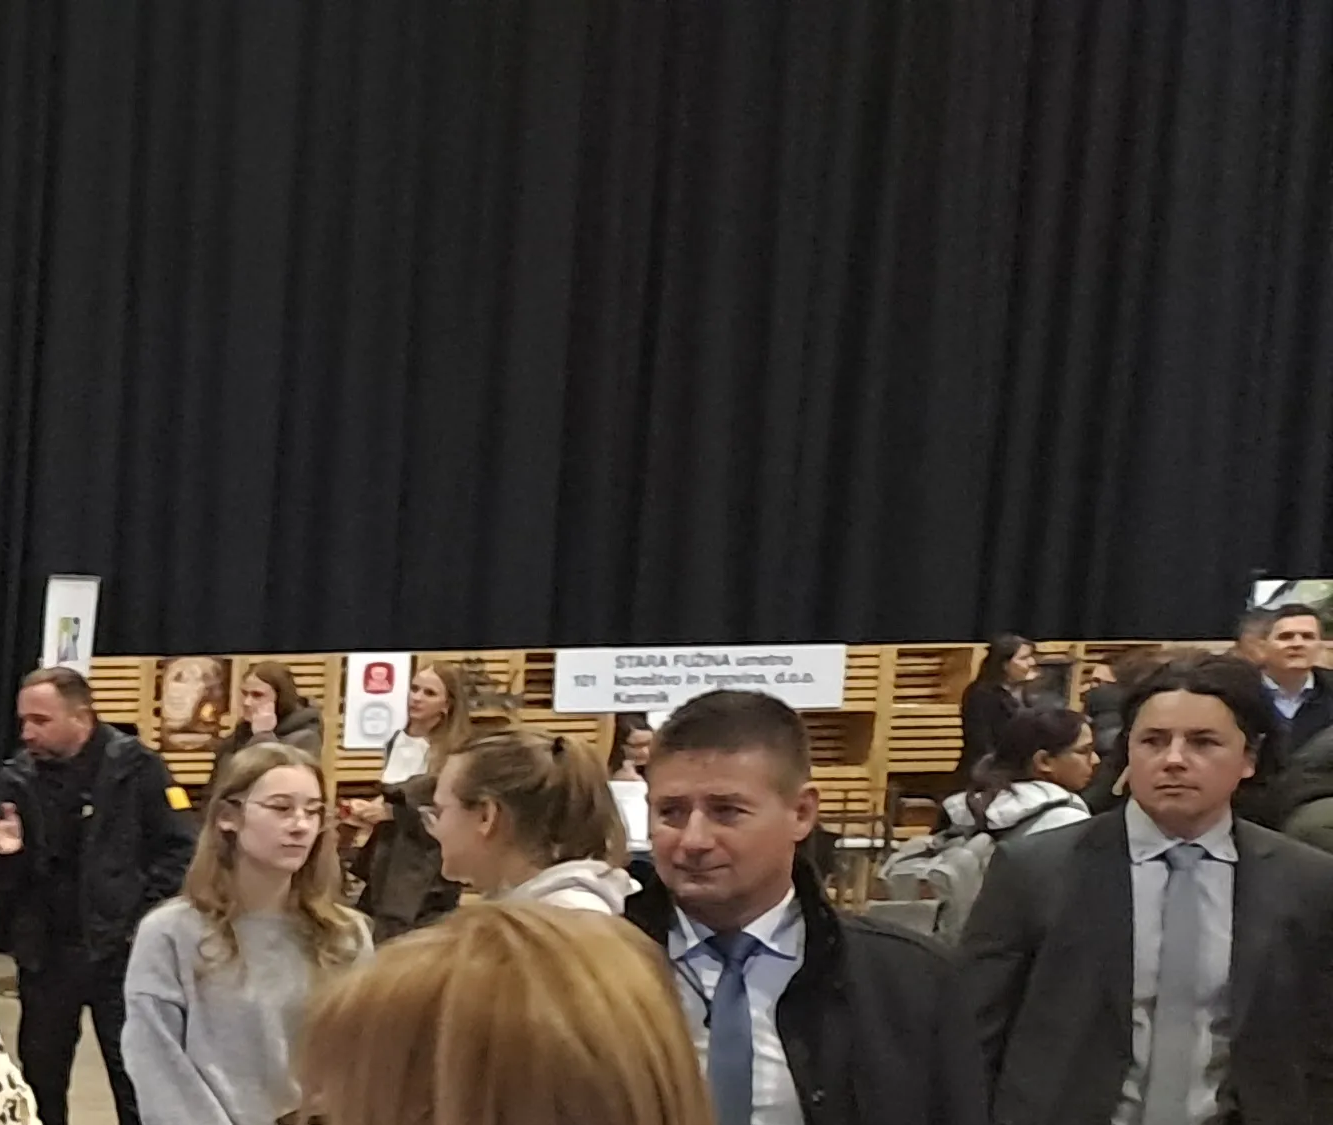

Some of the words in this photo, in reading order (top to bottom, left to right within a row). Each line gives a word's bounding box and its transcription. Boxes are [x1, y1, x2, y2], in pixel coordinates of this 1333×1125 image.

[615, 655, 667, 669] STARA
[674, 653, 730, 667] FUŽINA
[574, 674, 596, 687] 101
